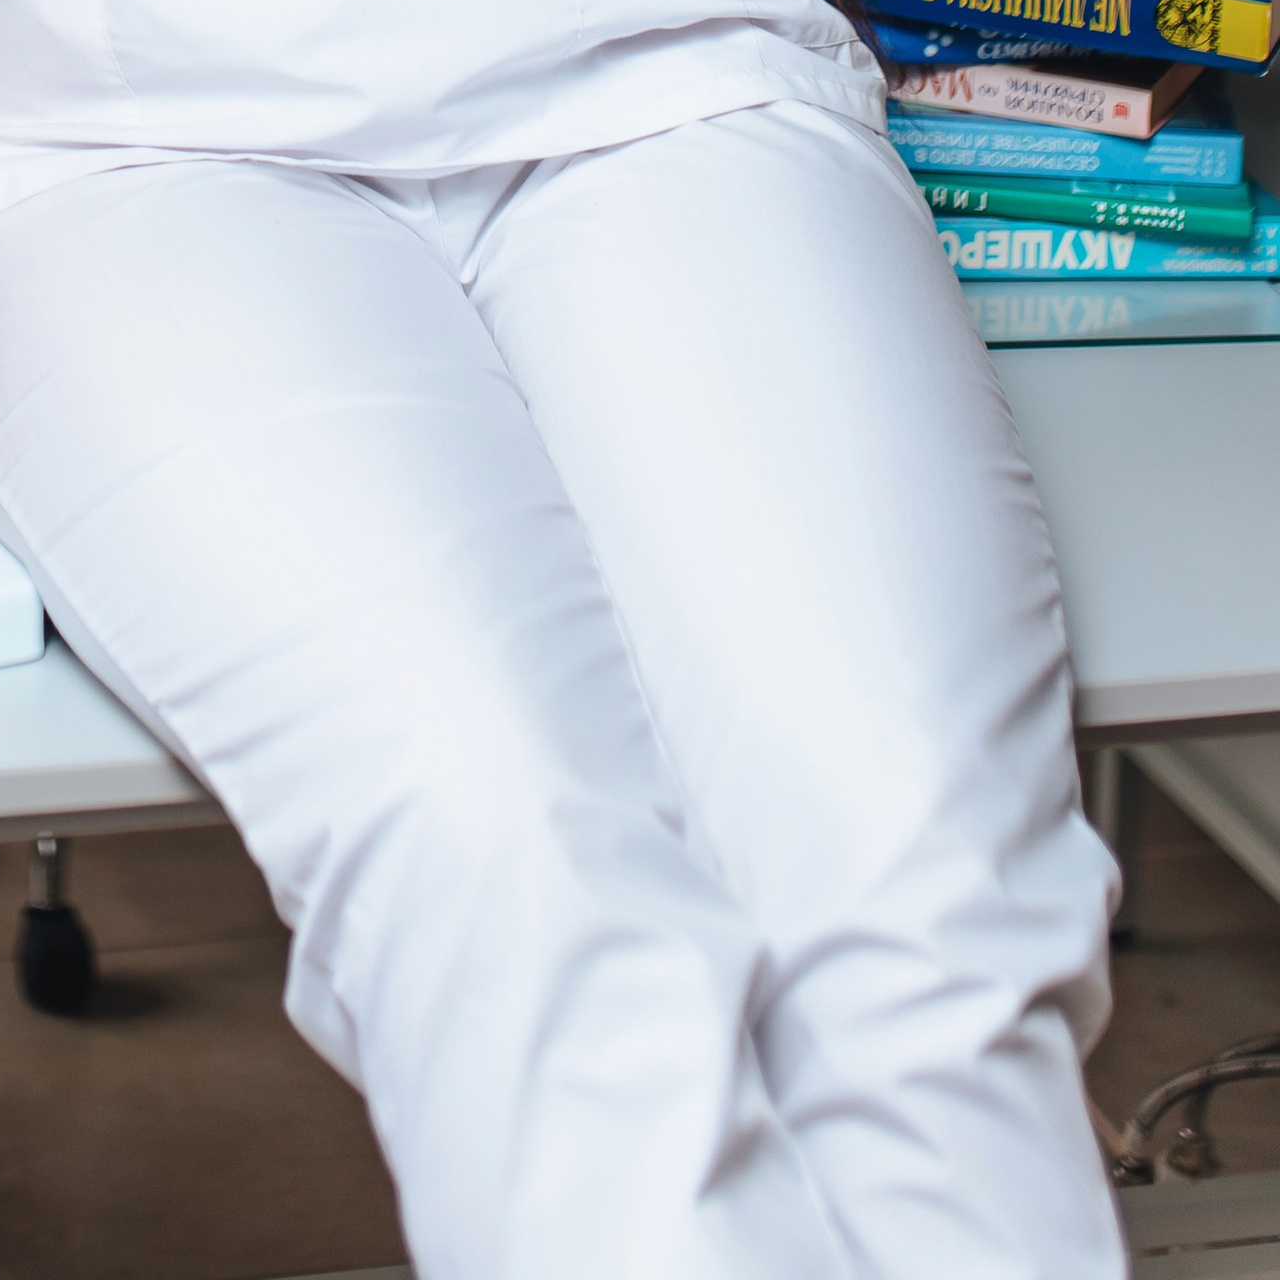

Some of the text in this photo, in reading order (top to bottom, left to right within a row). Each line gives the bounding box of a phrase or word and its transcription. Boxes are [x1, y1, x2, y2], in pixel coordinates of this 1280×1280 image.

[1005, 77, 1107, 107] СПРАВОЧНИК
[1005, 96, 1106, 125] БОЛЬШОЙ
[973, 135, 989, 149] И
[991, 136, 1101, 154] АКУШЕРСТВЕ
[929, 149, 977, 166] ДЕЛО
[978, 151, 1101, 172] СЕСТРИНСКОЕ
